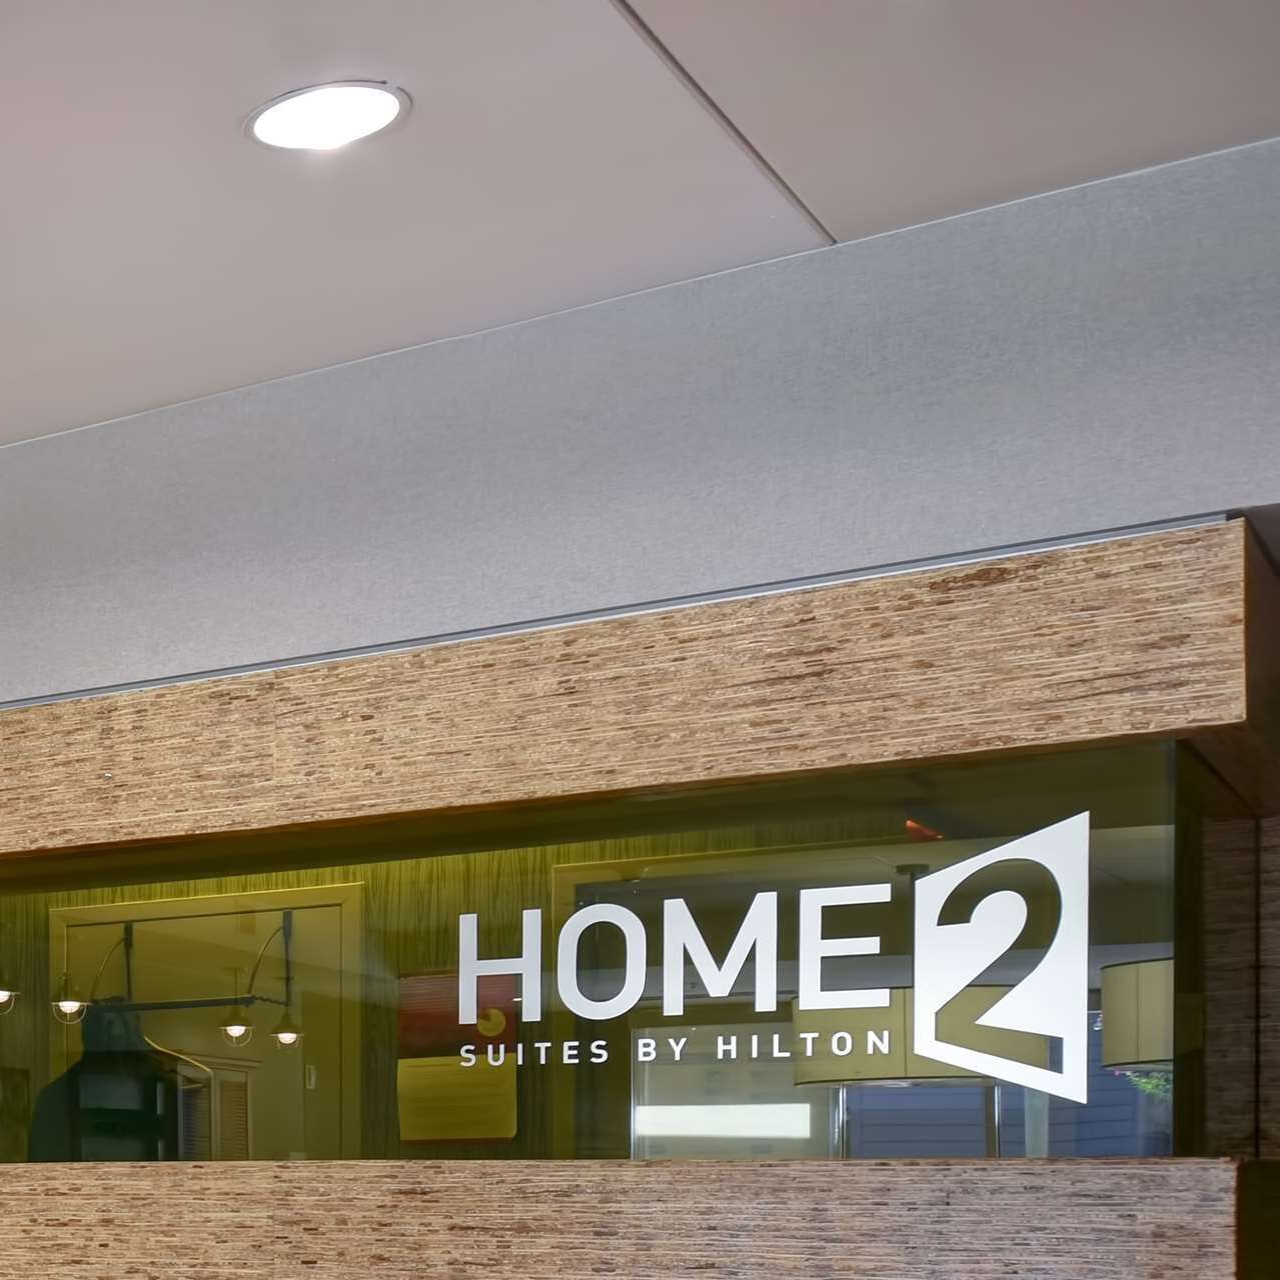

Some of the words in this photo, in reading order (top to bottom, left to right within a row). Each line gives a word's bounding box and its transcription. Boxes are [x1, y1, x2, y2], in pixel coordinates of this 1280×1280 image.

[457, 882, 892, 1025] HOME
[923, 832, 1077, 1092] 2
[458, 1038, 610, 1068] SUITES
[637, 1036, 689, 1063] BY
[715, 1029, 893, 1061] HILTON
